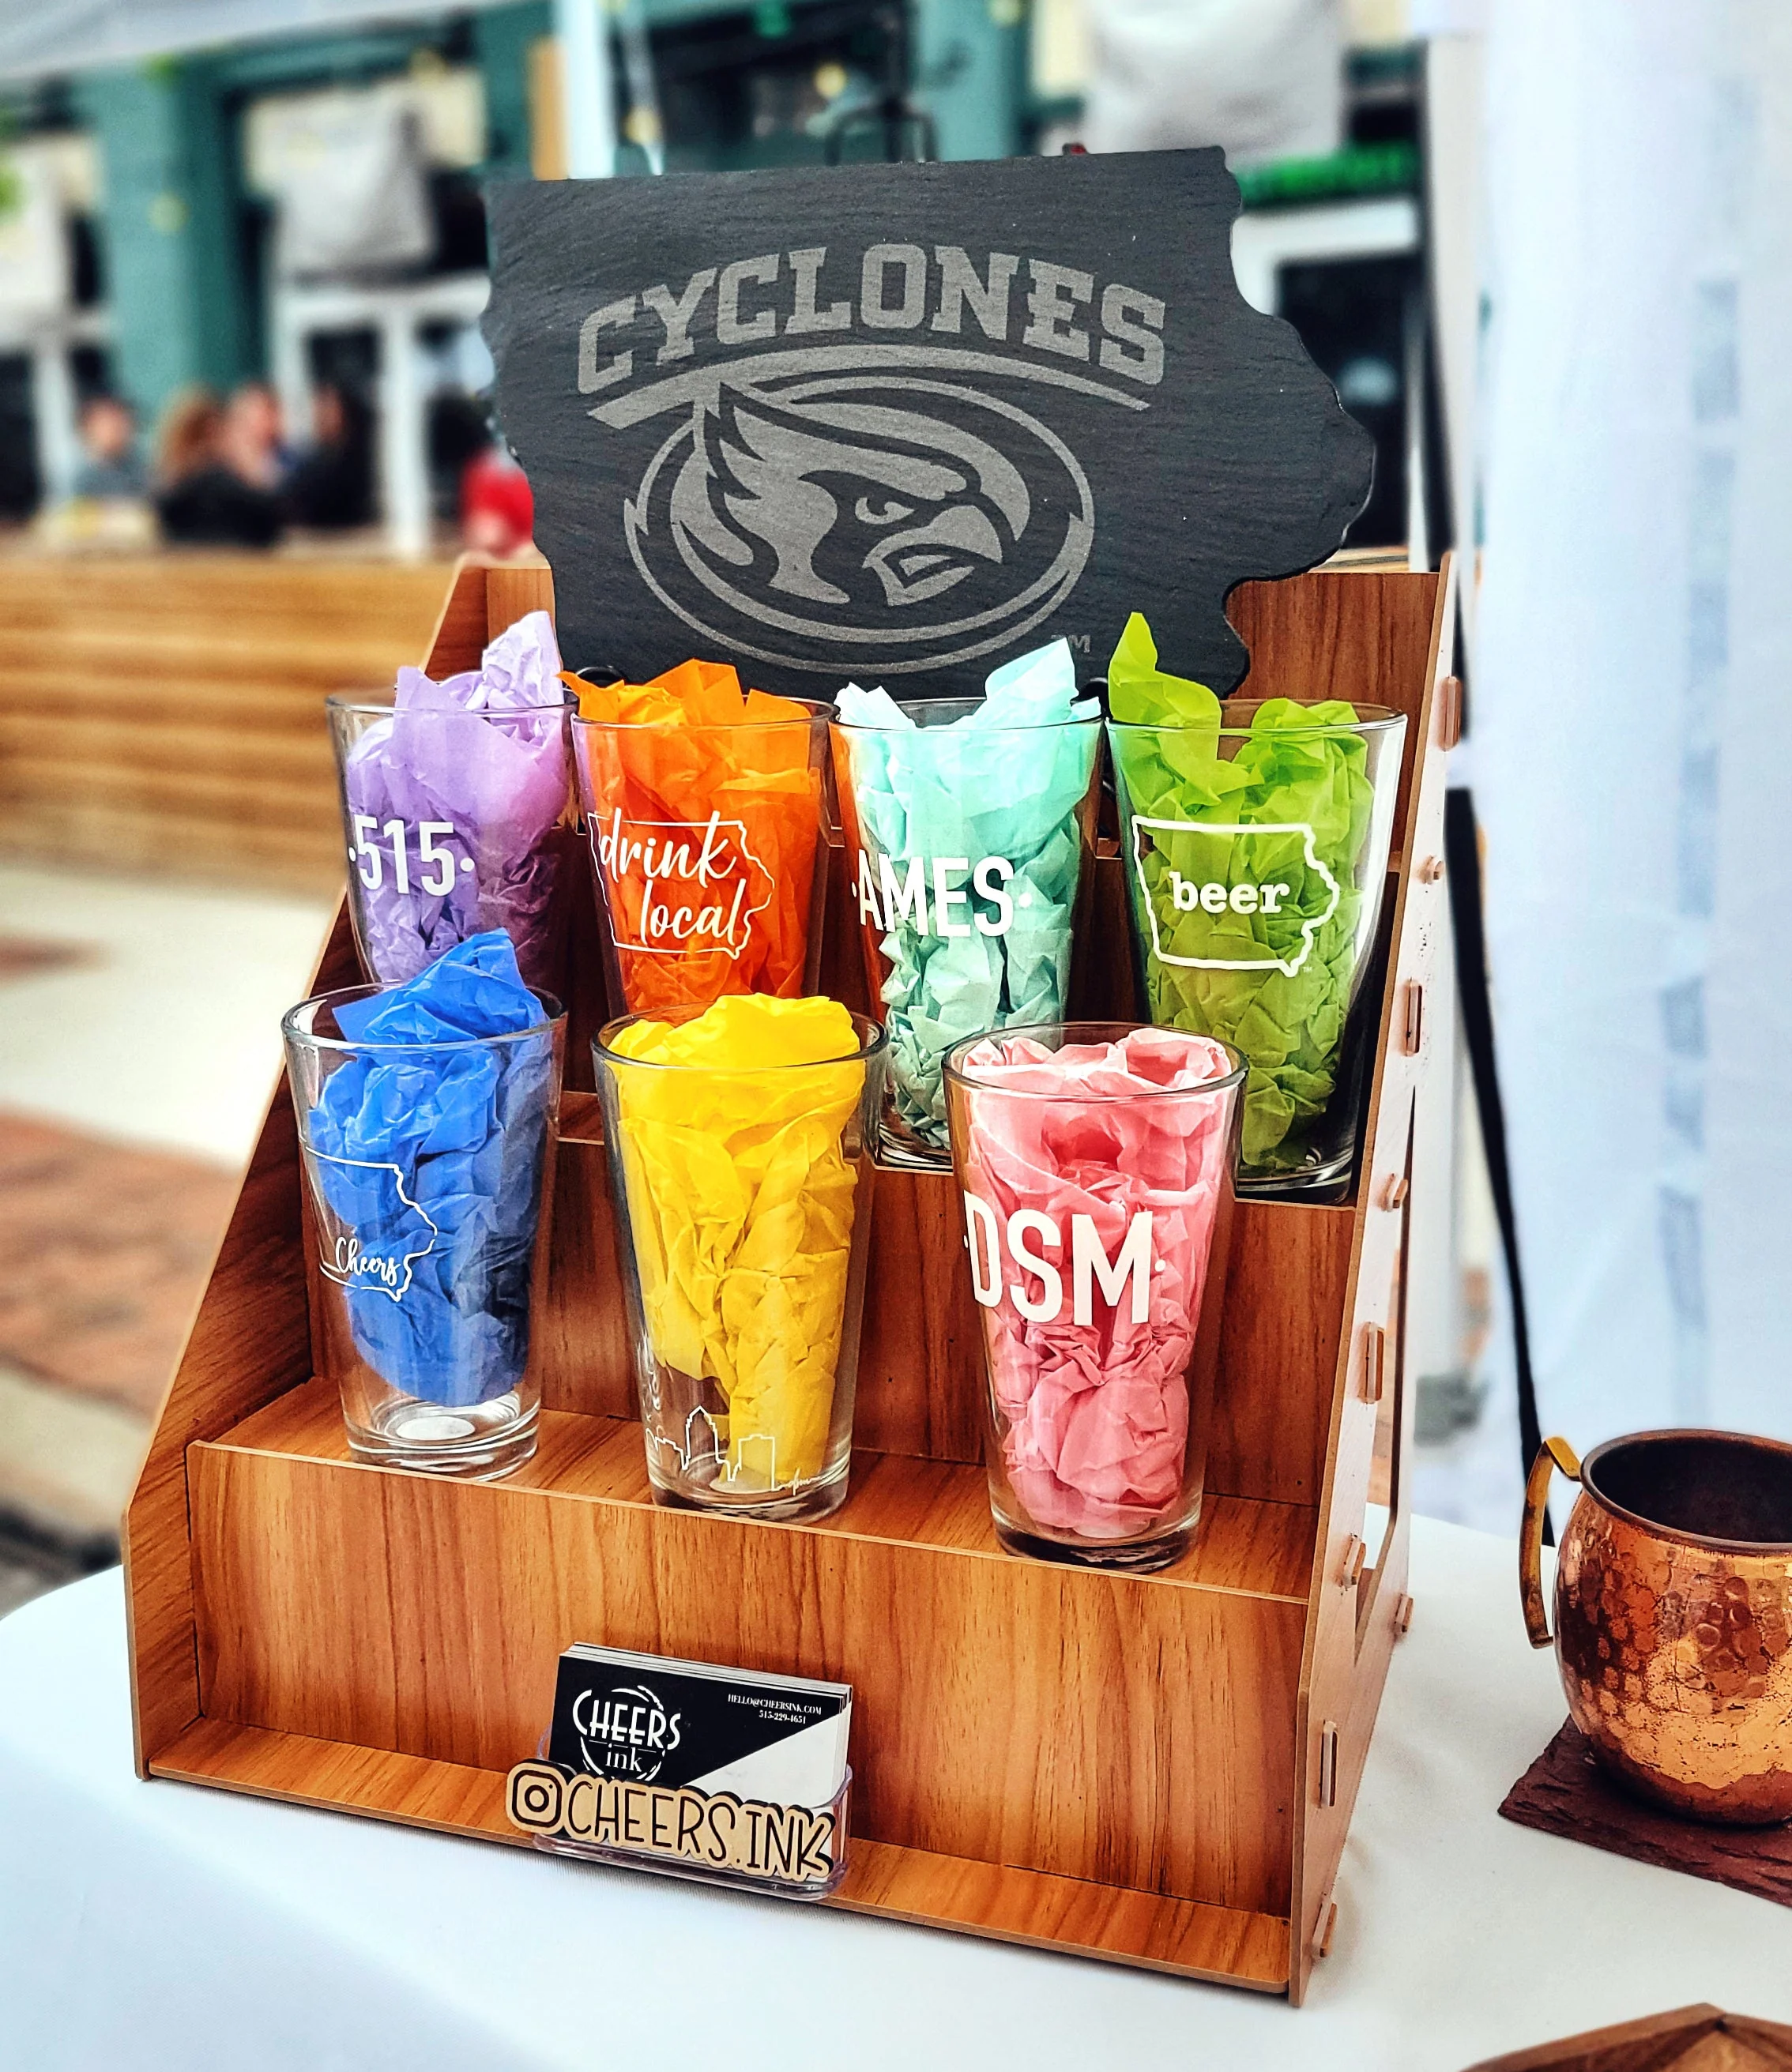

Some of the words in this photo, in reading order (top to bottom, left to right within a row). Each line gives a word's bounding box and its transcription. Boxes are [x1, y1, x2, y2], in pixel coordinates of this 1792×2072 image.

[578, 243, 1166, 394] CYCLONES
[1051, 634, 1090, 653] M
[599, 807, 736, 888] drink
[639, 878, 747, 946] local
[858, 848, 1015, 937] AMES
[1169, 871, 1290, 915] beer
[335, 1236, 401, 1287] Cheers
[963, 1190, 1154, 1326] DSM
[572, 1689, 682, 1750] CHEERS
[728, 1693, 822, 1715] HELLO@CHEERSINK.COM
[605, 1743, 643, 1773] ink
